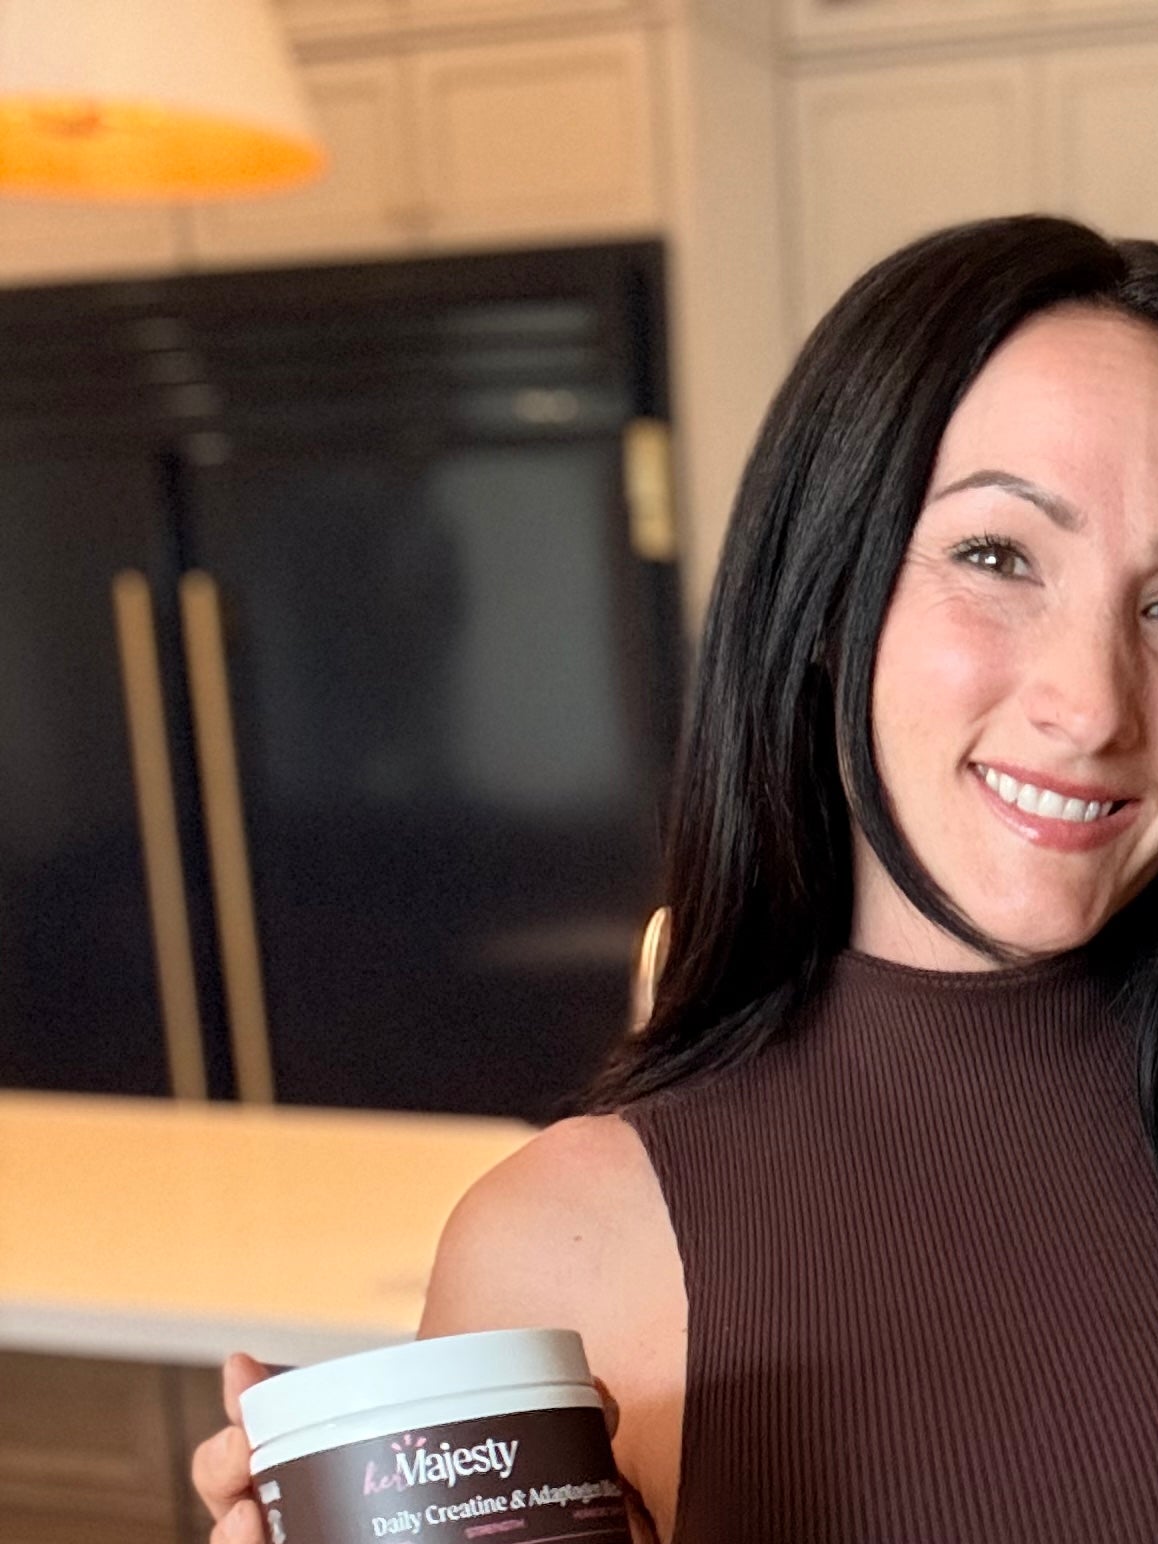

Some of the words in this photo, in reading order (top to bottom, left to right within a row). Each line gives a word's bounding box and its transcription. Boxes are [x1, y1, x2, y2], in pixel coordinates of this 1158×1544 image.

[394, 1438, 519, 1488] Majesty
[371, 1510, 423, 1537] Daily
[425, 1495, 508, 1525] Creatine
[509, 1489, 527, 1511] &
